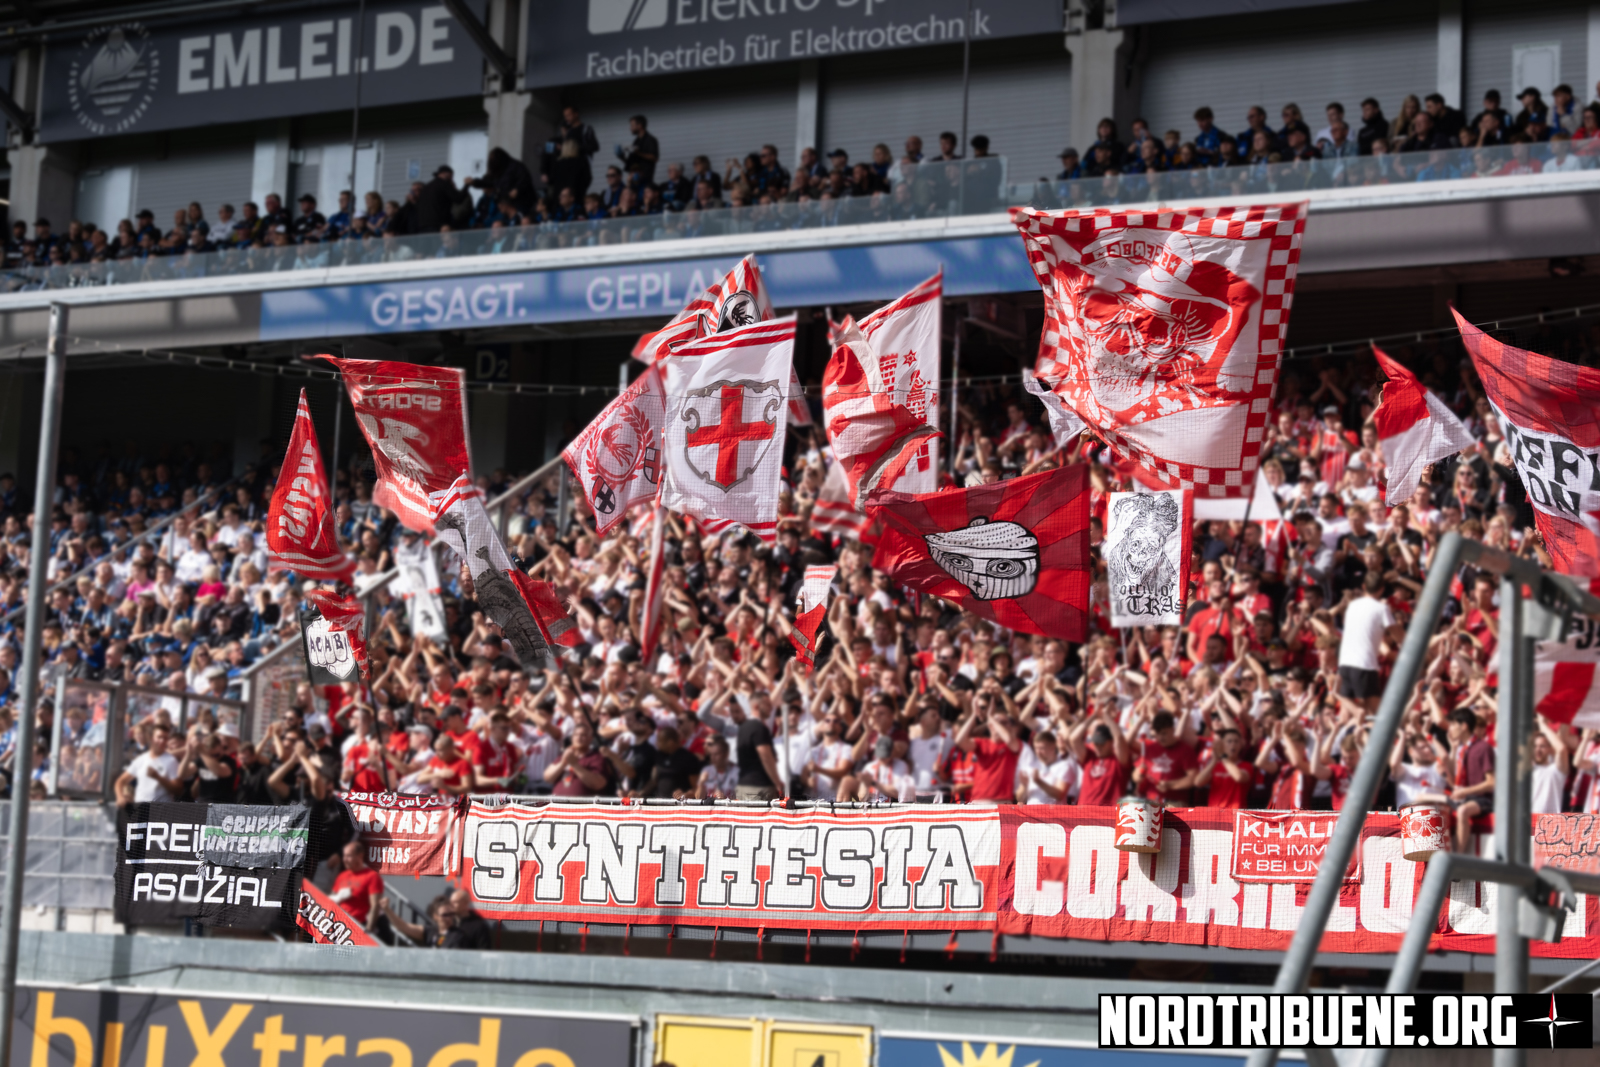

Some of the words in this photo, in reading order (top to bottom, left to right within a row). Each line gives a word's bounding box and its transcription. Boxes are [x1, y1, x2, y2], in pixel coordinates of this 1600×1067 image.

[176, 5, 455, 96] EMLEI.DE
[585, 38, 736, 80] Fachbetrieb
[742, 34, 782, 62] für
[370, 281, 528, 328] GESAGT.
[585, 264, 766, 312] GEPLA
[308, 632, 345, 654] ACAB
[382, 795, 393, 803] 74
[221, 814, 290, 834] GRUPPE
[368, 846, 411, 864] ULTRAS
[1240, 839, 1280, 856] FÜR
[471, 819, 985, 911] SYNTHESIA
[1012, 821, 1426, 936] CORRO
[1256, 859, 1287, 872] BEI
